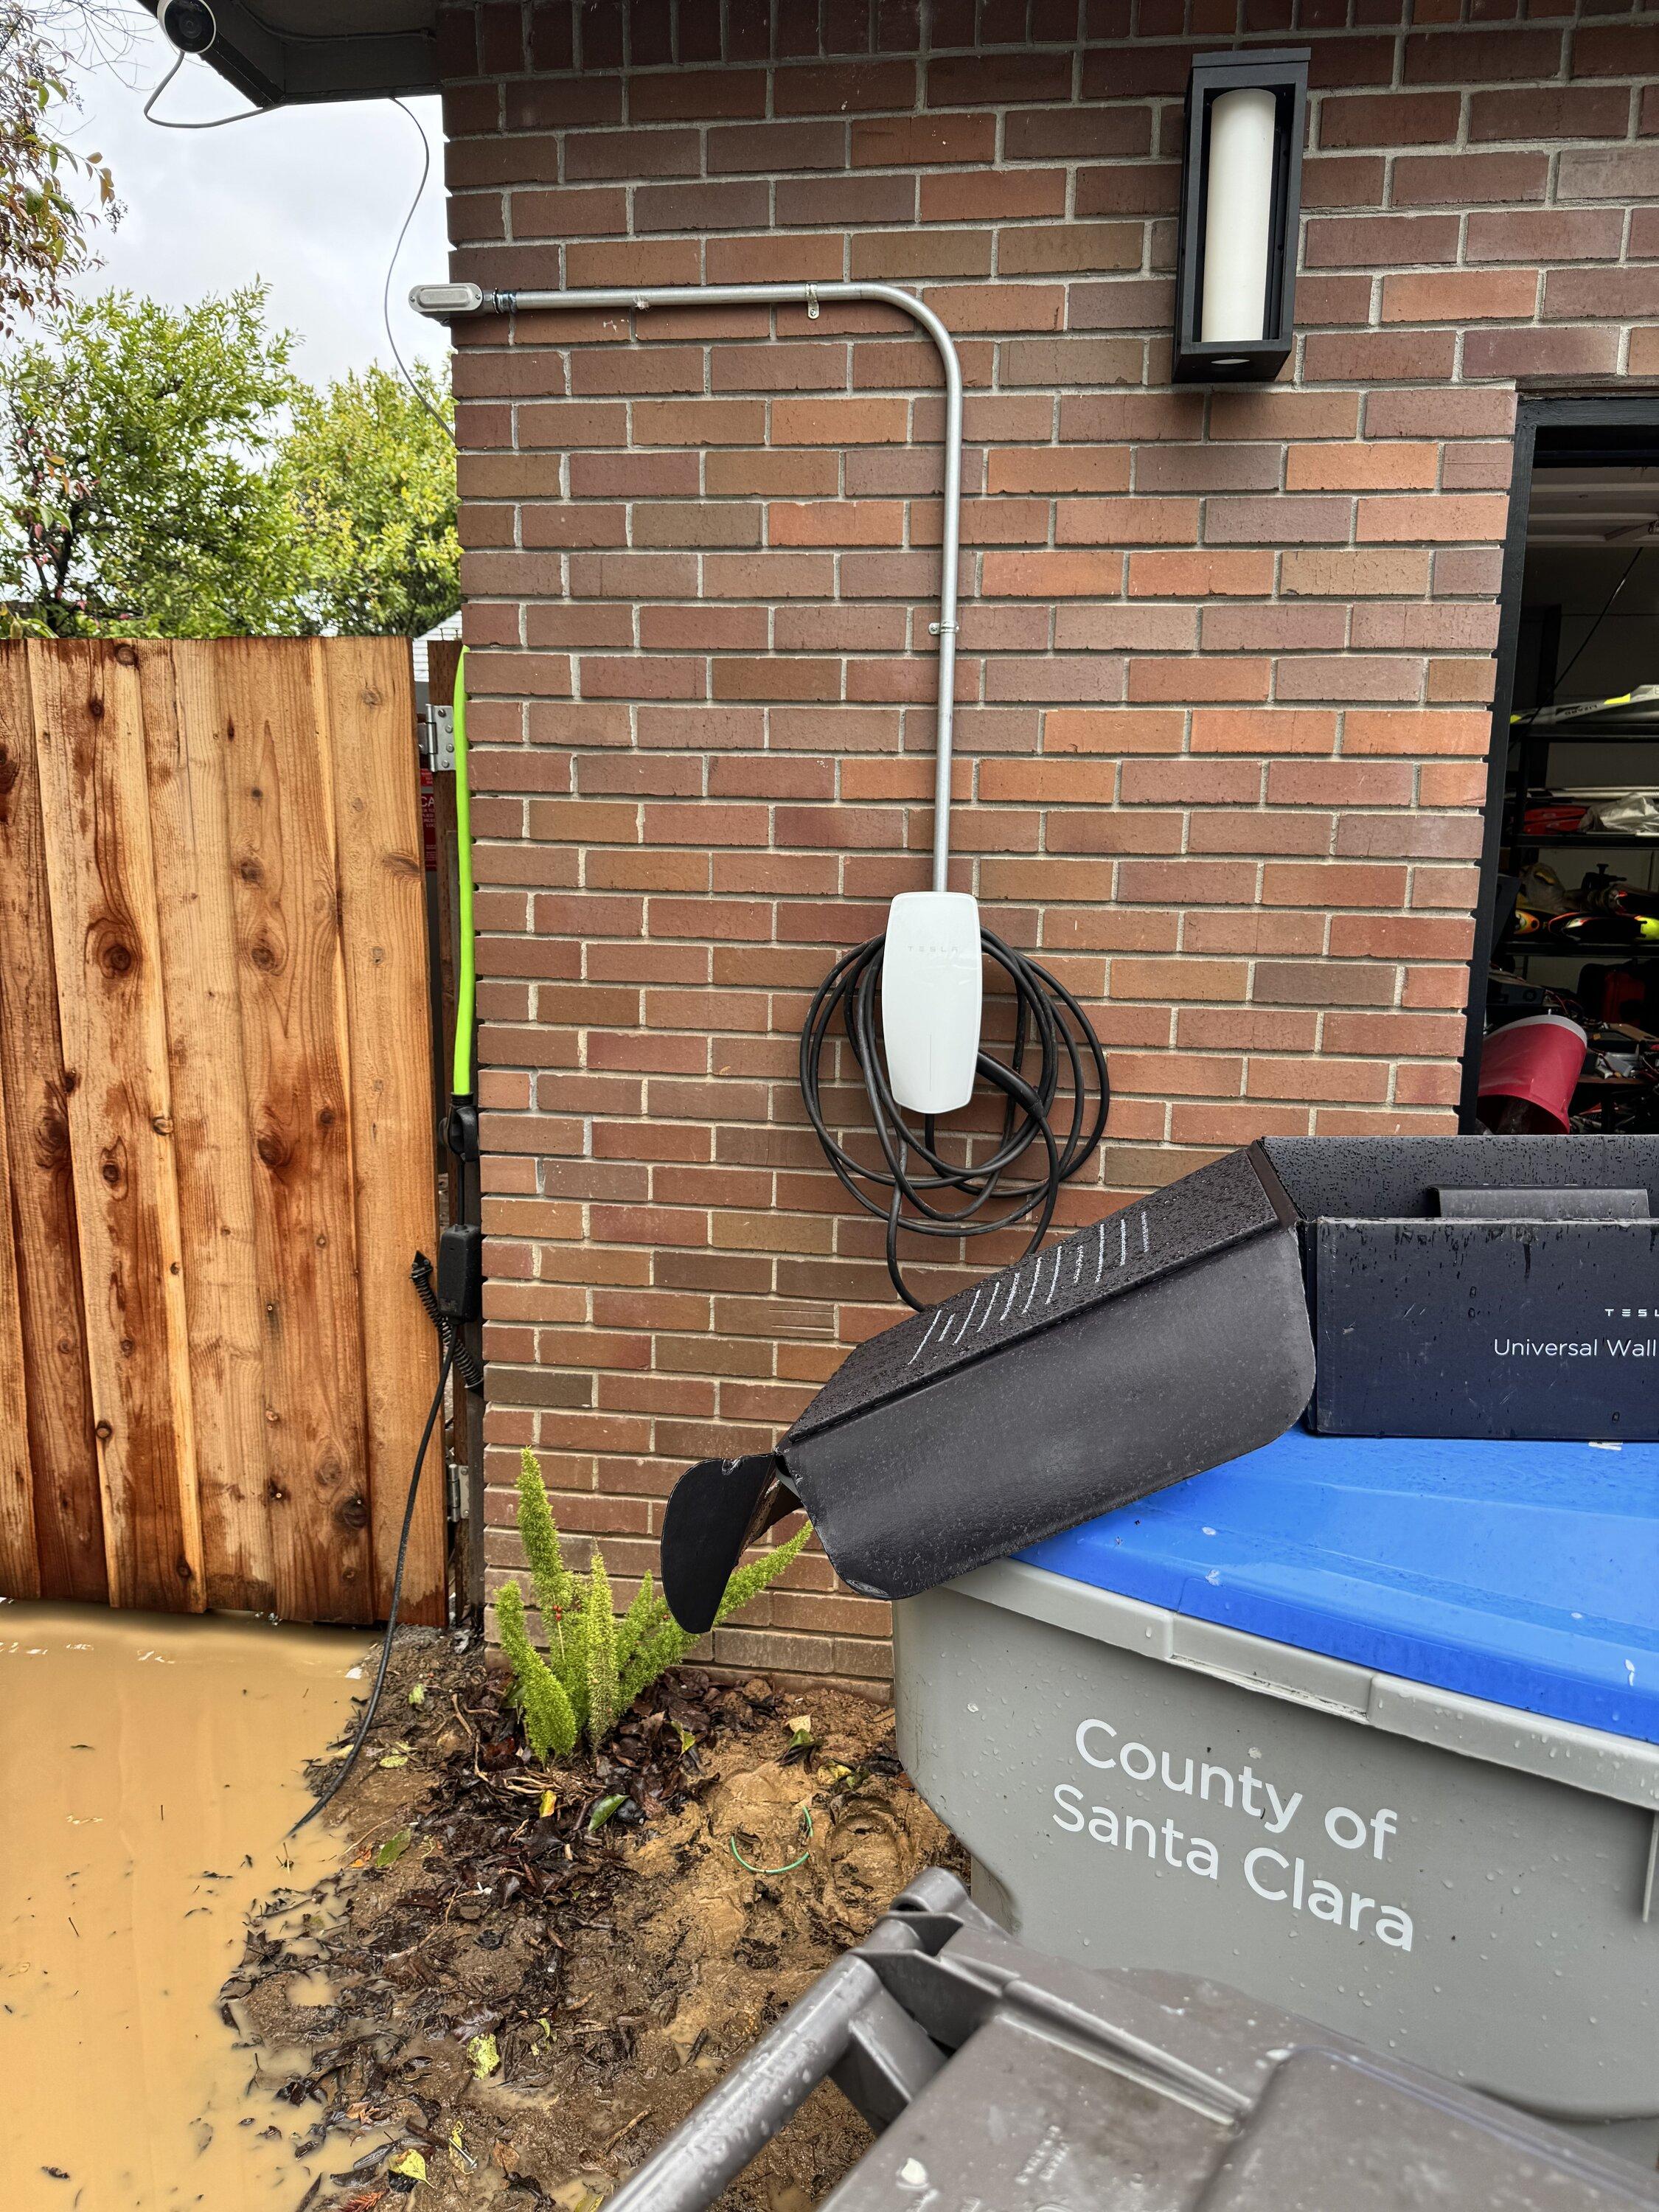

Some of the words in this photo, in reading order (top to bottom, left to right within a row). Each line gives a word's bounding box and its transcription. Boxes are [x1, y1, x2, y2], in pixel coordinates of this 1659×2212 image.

[1493, 1338, 1598, 1357] Universal
[1606, 1338, 1657, 1357] Wall
[1075, 1718, 1303, 1834] County
[1324, 1806, 1398, 1860] of
[1052, 1784, 1219, 1880] Santa
[1244, 1847, 1413, 1952] Clara
